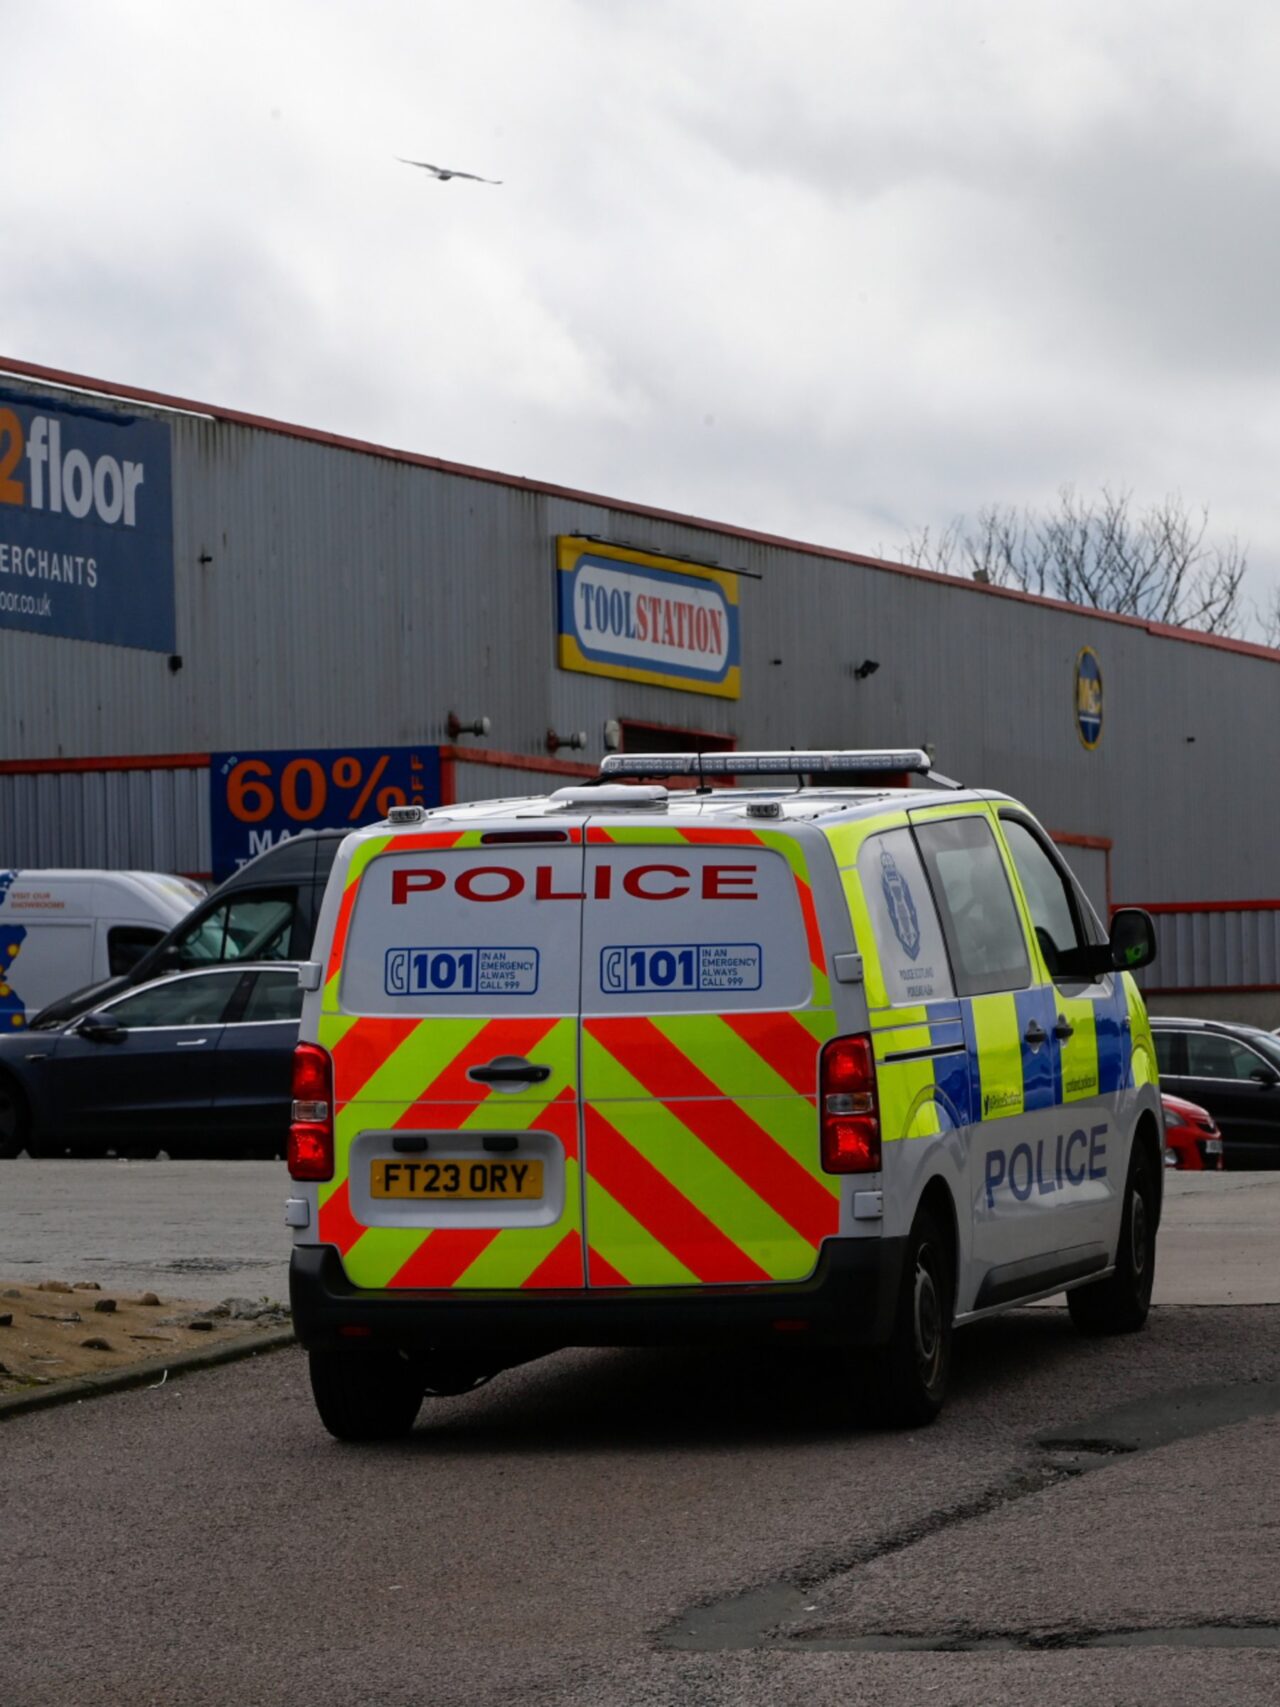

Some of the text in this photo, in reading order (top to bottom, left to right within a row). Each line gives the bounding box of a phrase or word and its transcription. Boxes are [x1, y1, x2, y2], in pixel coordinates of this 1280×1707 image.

[0, 543, 98, 588] ERCHANTS
[580, 582, 722, 655] TOOLSTATION
[226, 755, 408, 823] 60%
[391, 864, 758, 905] POLICE
[493, 952, 506, 960] AN
[702, 949, 727, 957] IN AN
[702, 958, 757, 967] EMERGENCY
[413, 953, 473, 989] 101
[480, 971, 515, 980] ALWAYS
[481, 961, 534, 971] EMERGENCY
[630, 950, 693, 986] 101
[702, 968, 738, 976] ALWAYS
[480, 981, 520, 989] CALL 999
[702, 977, 743, 986] CALL 999
[985, 1123, 1108, 1209] POLICE
[384, 1164, 529, 1192] FT23 ORY
